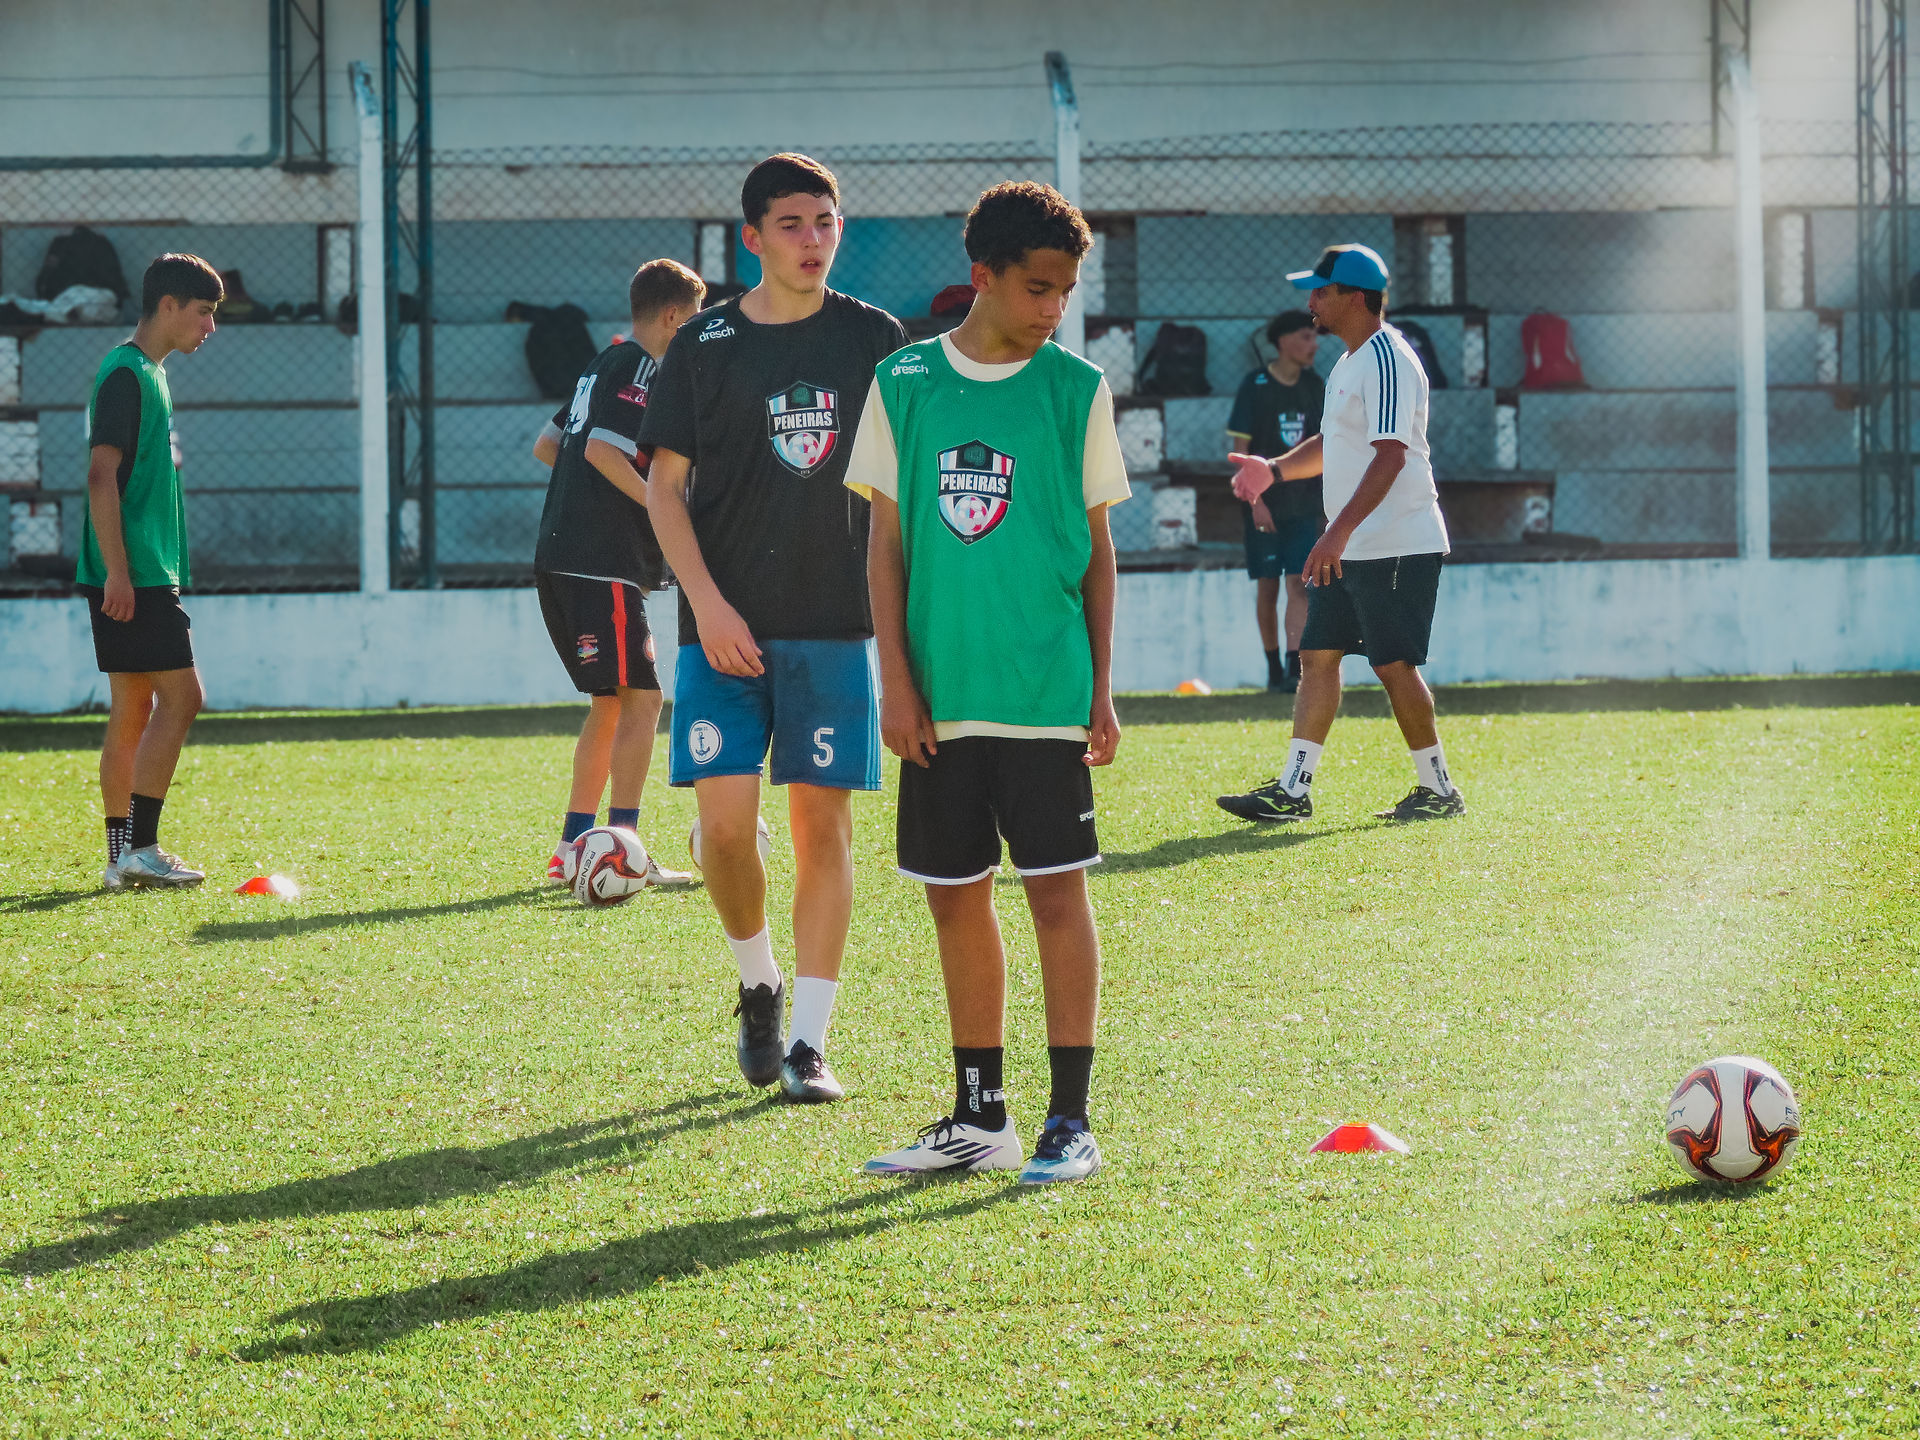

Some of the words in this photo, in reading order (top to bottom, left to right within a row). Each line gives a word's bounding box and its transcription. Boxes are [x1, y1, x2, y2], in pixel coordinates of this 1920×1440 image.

[698, 326, 735, 343] dresch
[891, 364, 929, 376] dresch
[773, 411, 833, 431] PENEIRAS
[940, 473, 1007, 494] PENEIRAS
[812, 727, 835, 768] 5
[578, 850, 596, 900] PENALT
